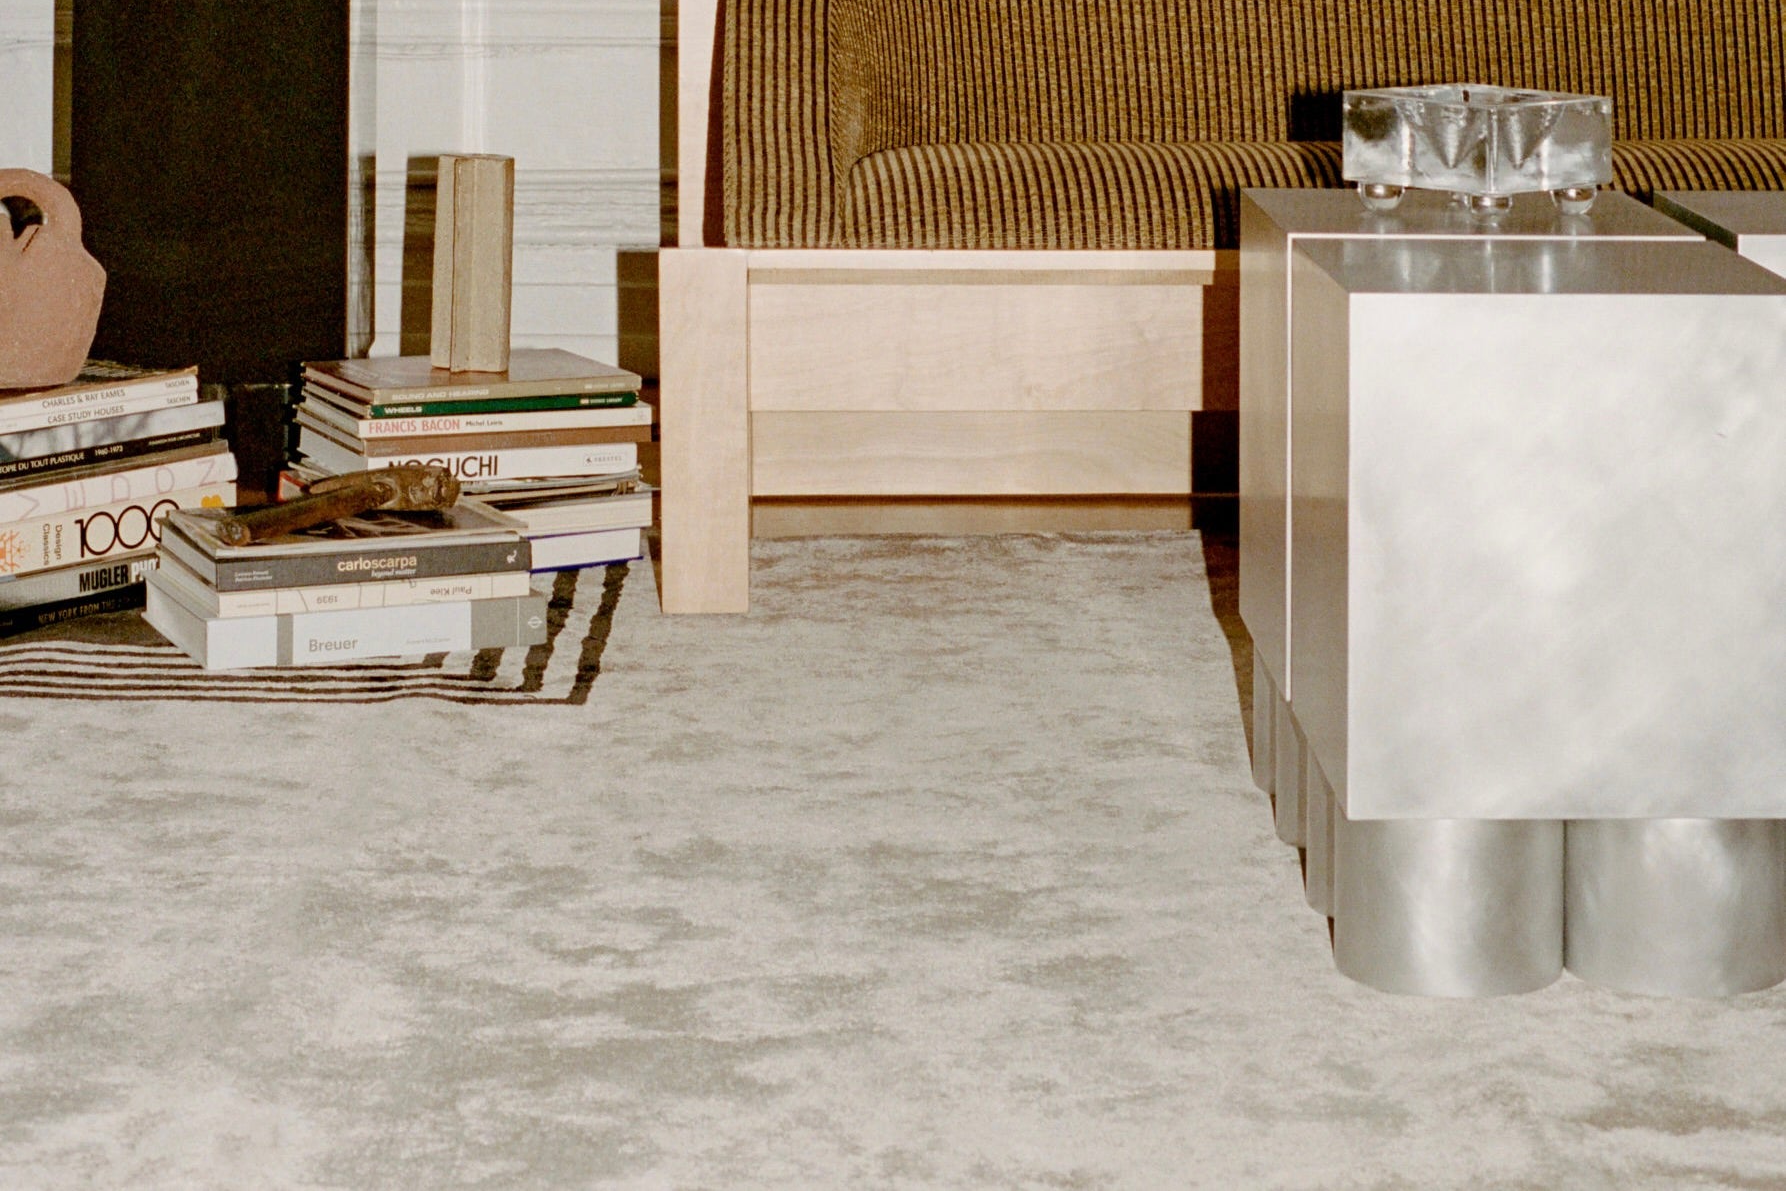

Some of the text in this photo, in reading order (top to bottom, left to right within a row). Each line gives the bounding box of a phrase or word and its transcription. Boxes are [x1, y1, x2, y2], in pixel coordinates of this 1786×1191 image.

[165, 379, 190, 388] TASCHEN
[42, 388, 126, 409] CHARLES & RAY EAMES
[166, 395, 191, 404] TASCHEN
[427, 391, 447, 399] AND
[47, 404, 125, 424] CASE STUDY HOUSES
[383, 405, 423, 415] WHEELS
[369, 419, 416, 434] FRANCIS
[420, 418, 460, 432] BACON
[18, 461, 30, 471] DU
[30, 458, 49, 469] TOUT
[49, 452, 85, 466] PLASTIQUE
[54, 523, 63, 560] Design
[337, 556, 418, 573] carloscarpa
[80, 563, 129, 593] MUGLER
[430, 585, 473, 596] Paul Klee
[316, 594, 338, 604] 1939
[38, 611, 56, 624] NEW
[57, 606, 77, 619] YORK
[79, 602, 100, 615] FROM
[308, 638, 359, 652] Breuer
